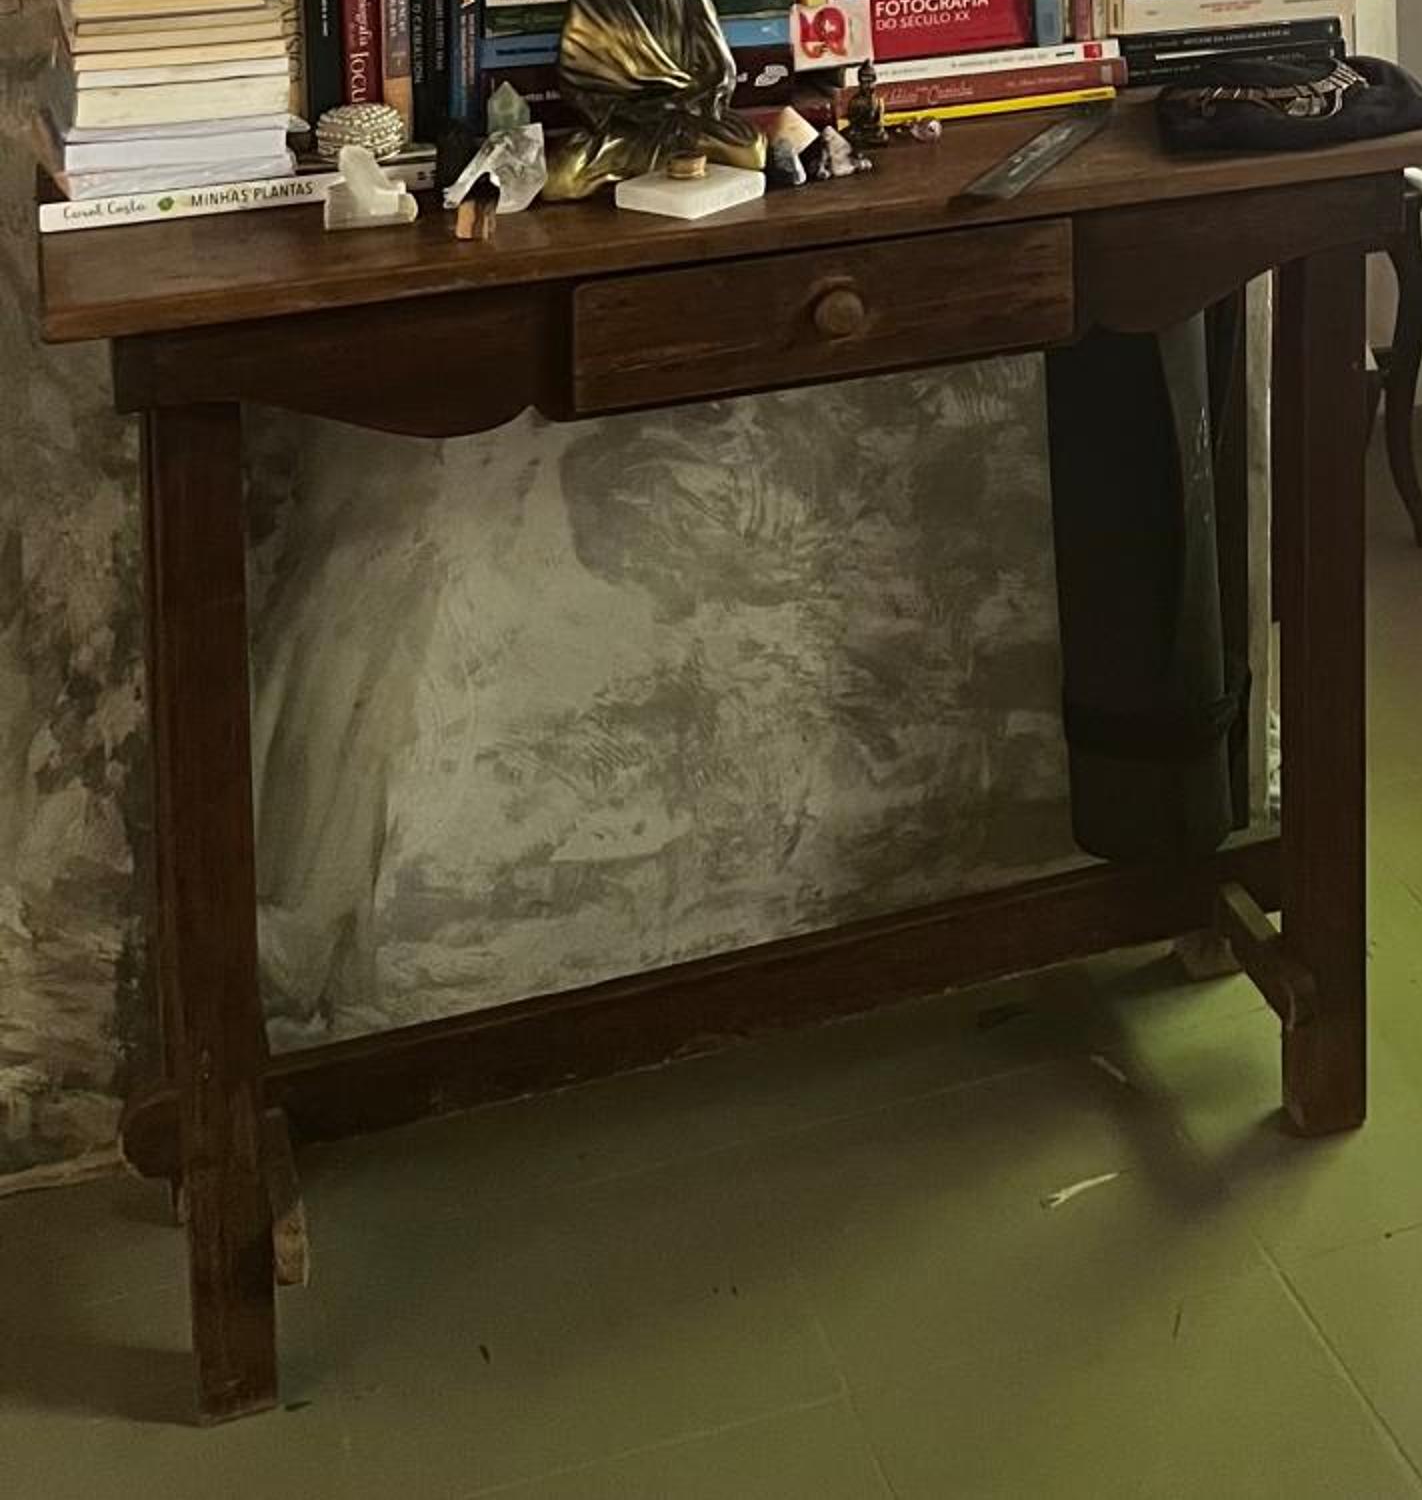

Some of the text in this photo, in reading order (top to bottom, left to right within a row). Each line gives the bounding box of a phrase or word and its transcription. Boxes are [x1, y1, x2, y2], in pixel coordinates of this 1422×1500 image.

[875, 18, 897, 31] DO
[954, 9, 970, 21] XX
[350, 52, 369, 104] IOGU
[191, 180, 314, 208] MINHAS PLANTAS
